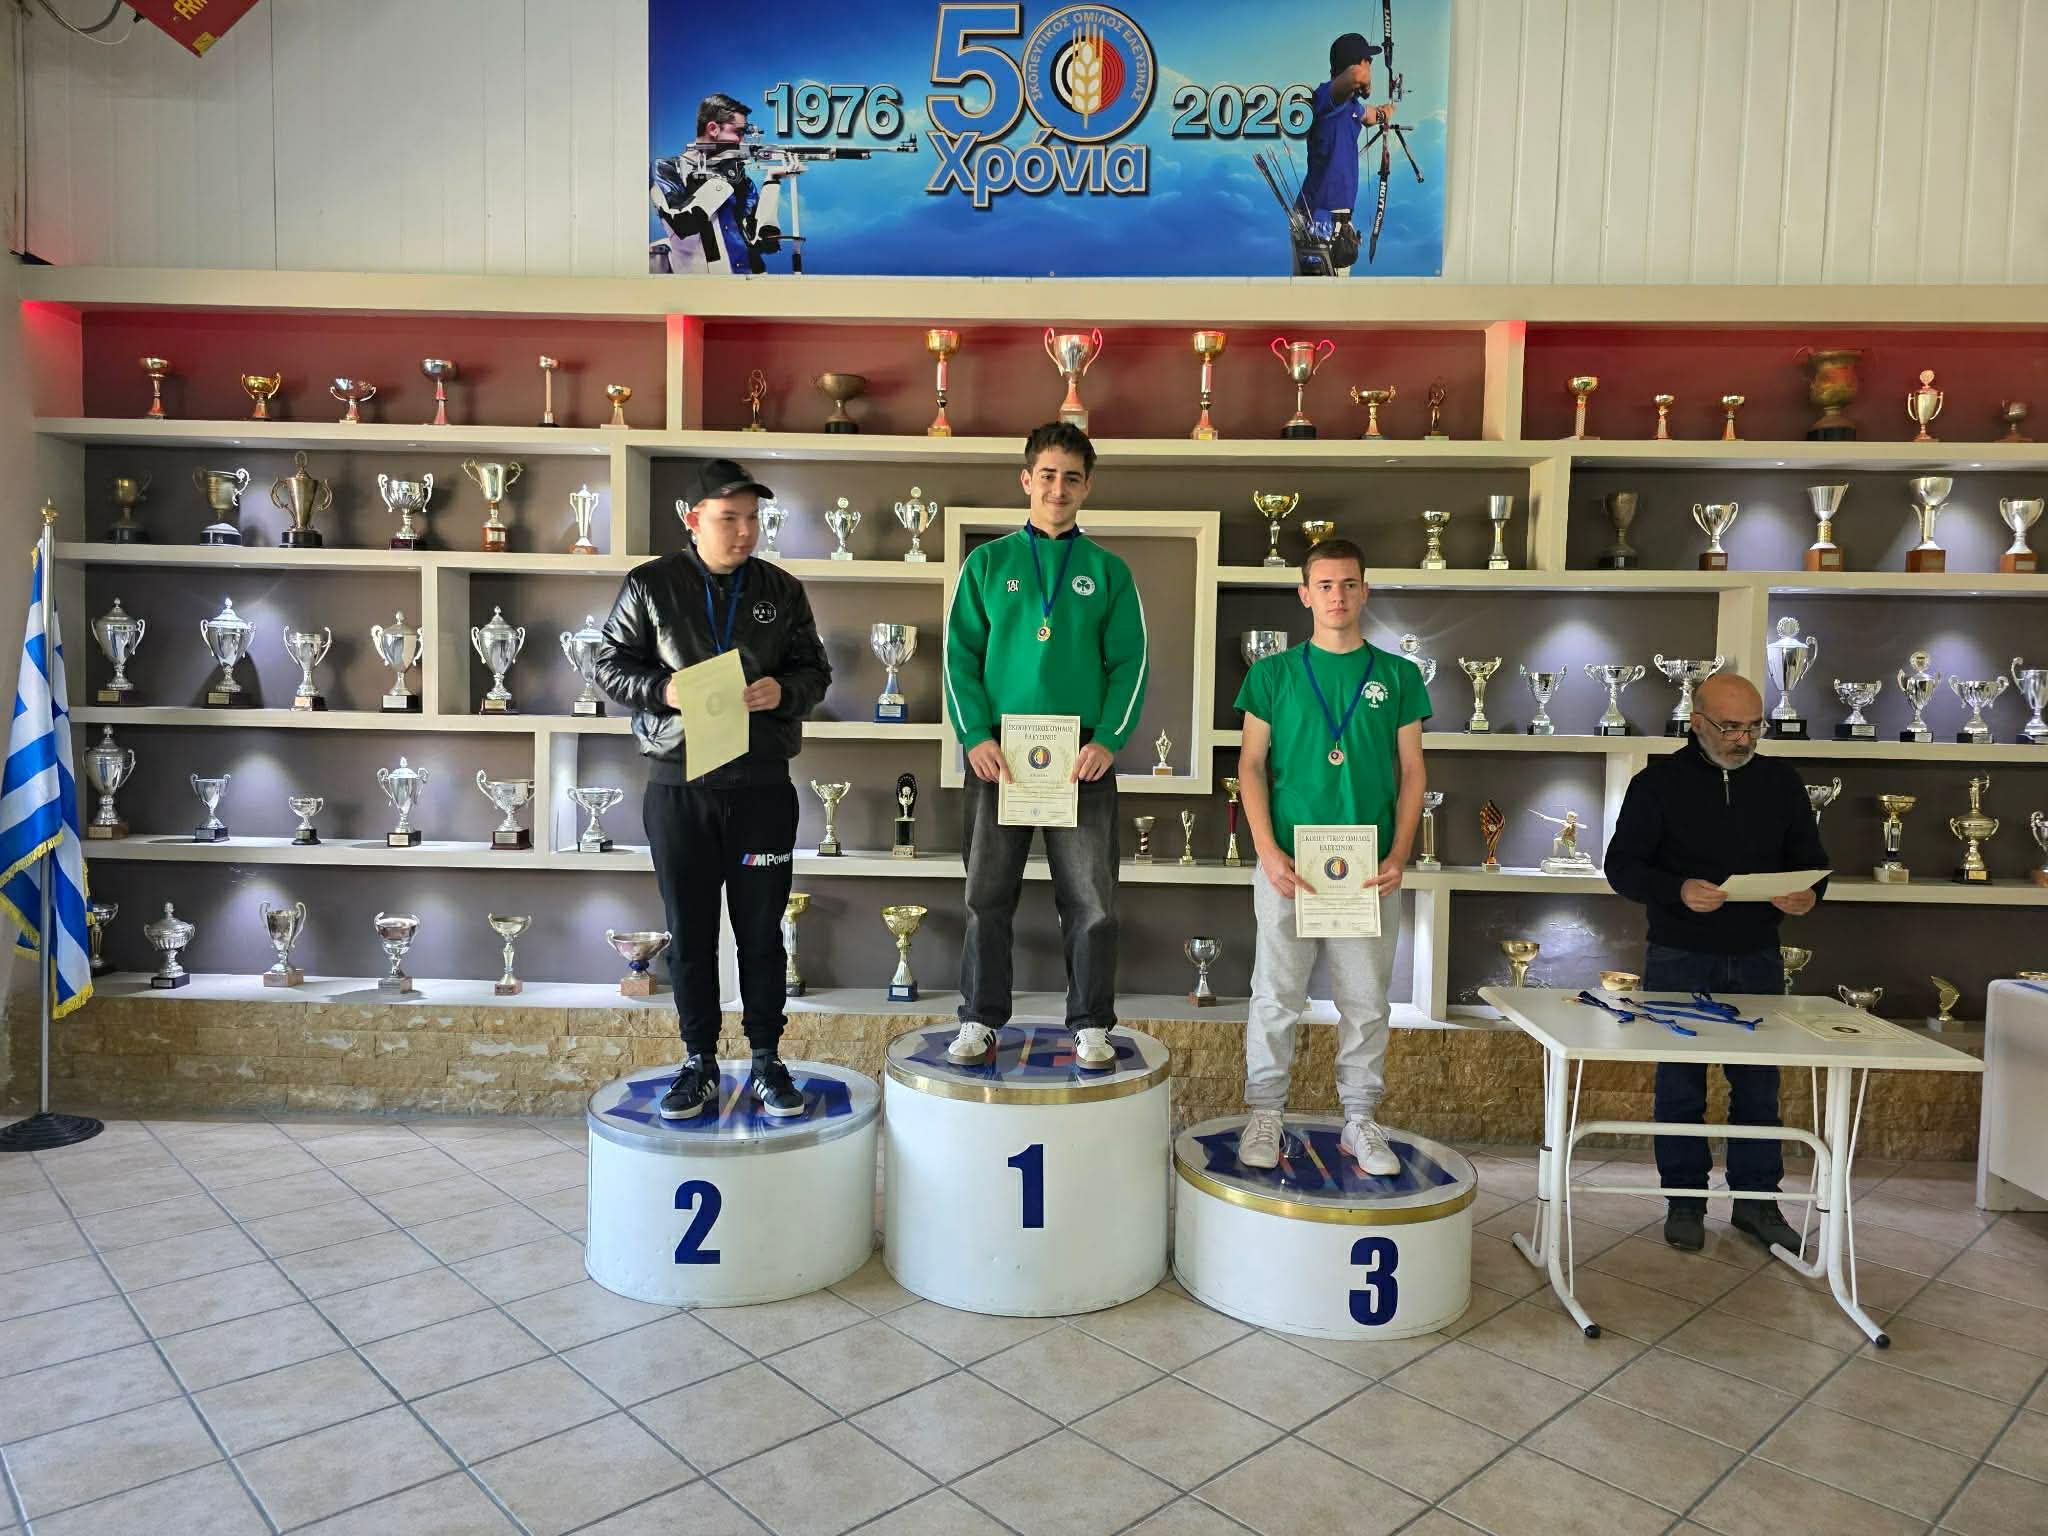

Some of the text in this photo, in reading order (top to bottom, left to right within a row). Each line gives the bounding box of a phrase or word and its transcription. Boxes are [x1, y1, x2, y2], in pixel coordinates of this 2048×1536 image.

[926, 3, 1154, 142] 50
[1027, 11, 1147, 102] ΣΚΟΠΕΥΤΙΚΟΣ ΟΜΙΛΟΣ ΕΛΕΥΣΙΝΑΣ
[765, 82, 902, 136] 1976
[1172, 83, 1314, 136] 2026
[926, 128, 1148, 207] Χρόνια
[1378, 181, 1387, 210] HOYT
[674, 1180, 721, 1264] 2
[1007, 1144, 1045, 1228] 1
[1349, 1237, 1399, 1325] 3
